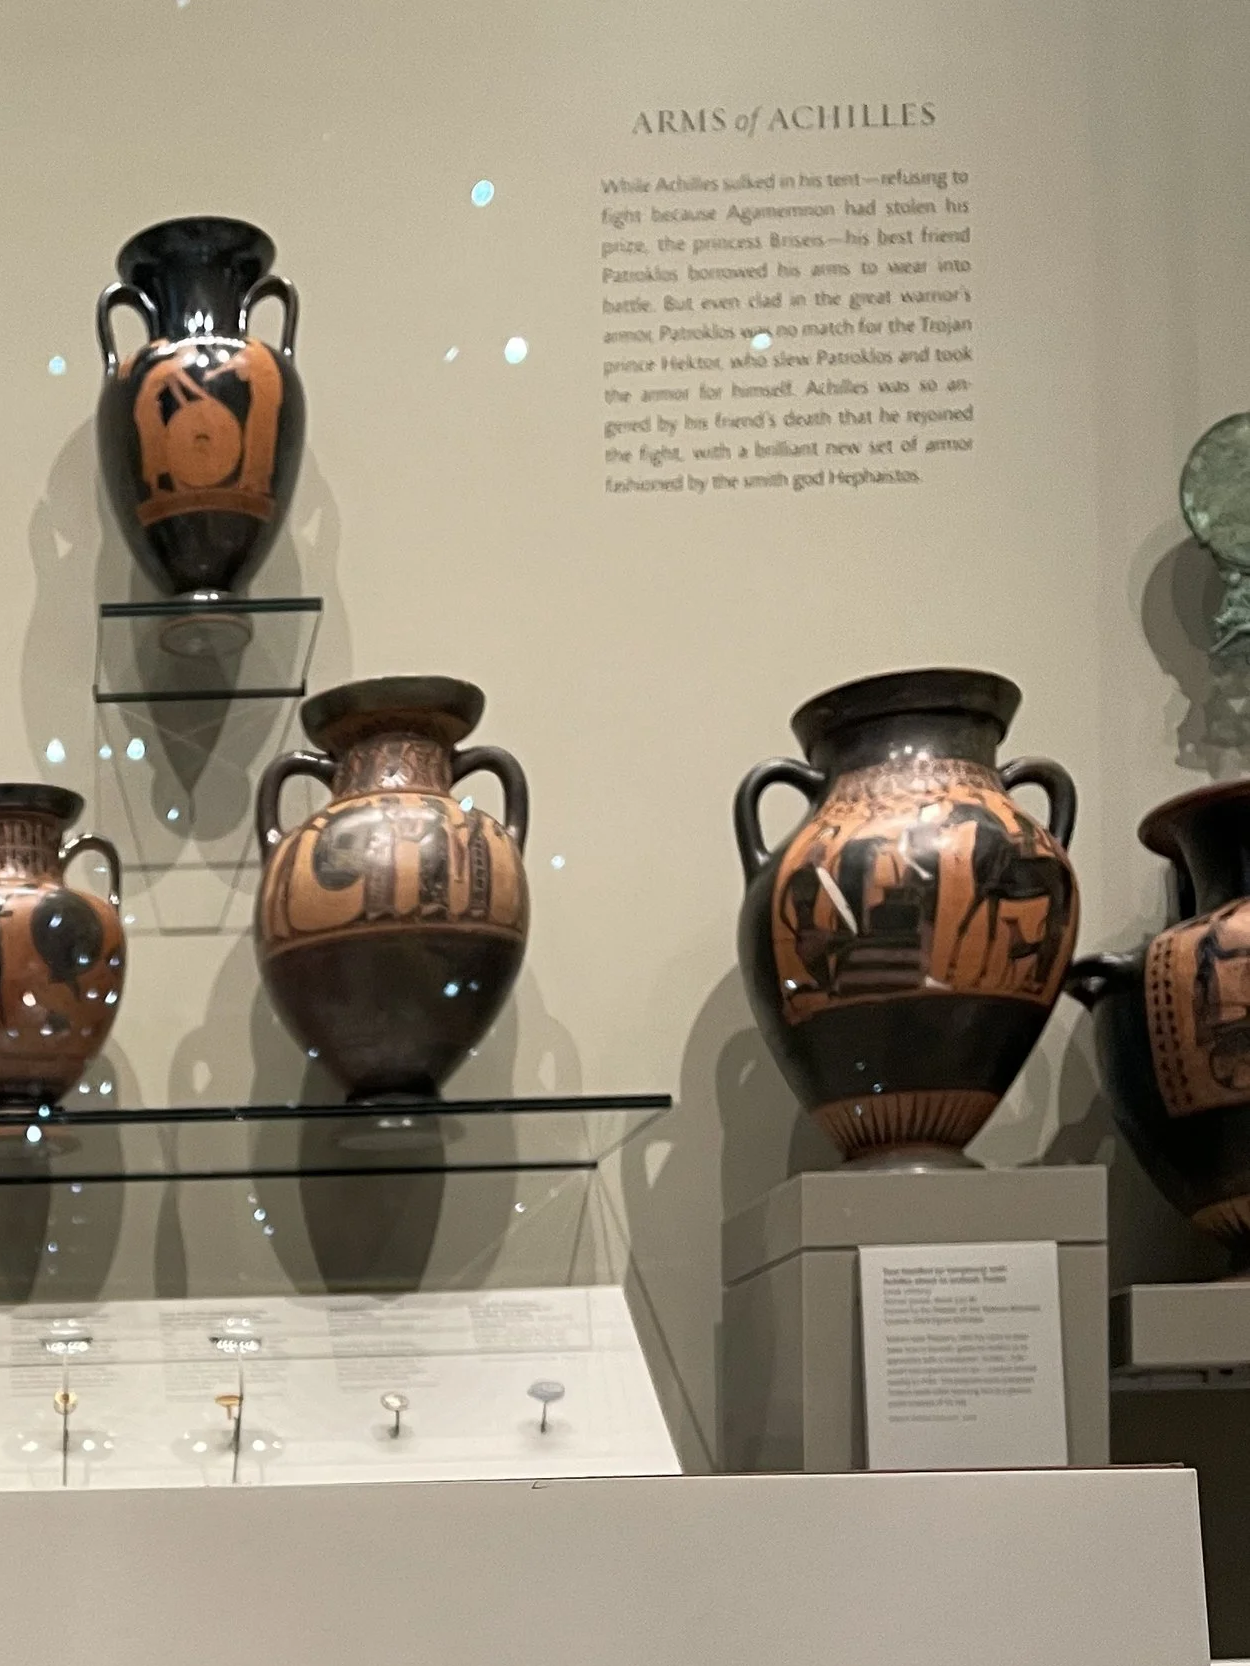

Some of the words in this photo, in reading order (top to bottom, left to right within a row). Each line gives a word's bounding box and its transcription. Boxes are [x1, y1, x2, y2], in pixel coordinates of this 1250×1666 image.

[631, 106, 727, 135] ARMS
[734, 104, 763, 137] of
[767, 101, 937, 132] ACHILLES
